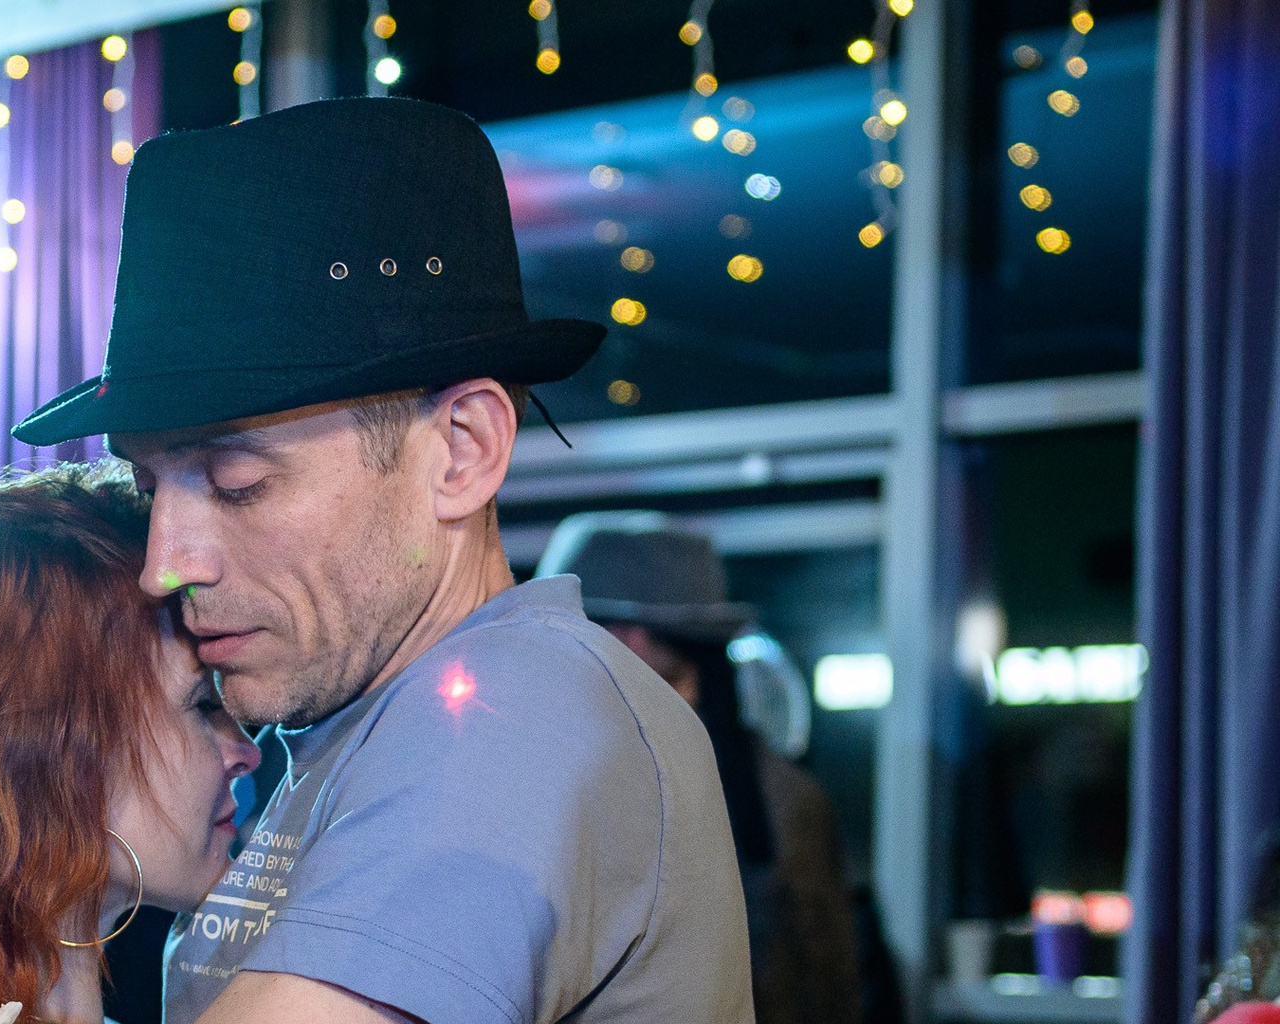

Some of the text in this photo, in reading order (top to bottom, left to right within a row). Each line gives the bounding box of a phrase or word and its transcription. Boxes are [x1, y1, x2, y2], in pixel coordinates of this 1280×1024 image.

[265, 855, 280, 870] BY
[246, 874, 269, 891] AND
[191, 912, 240, 943] TOM
